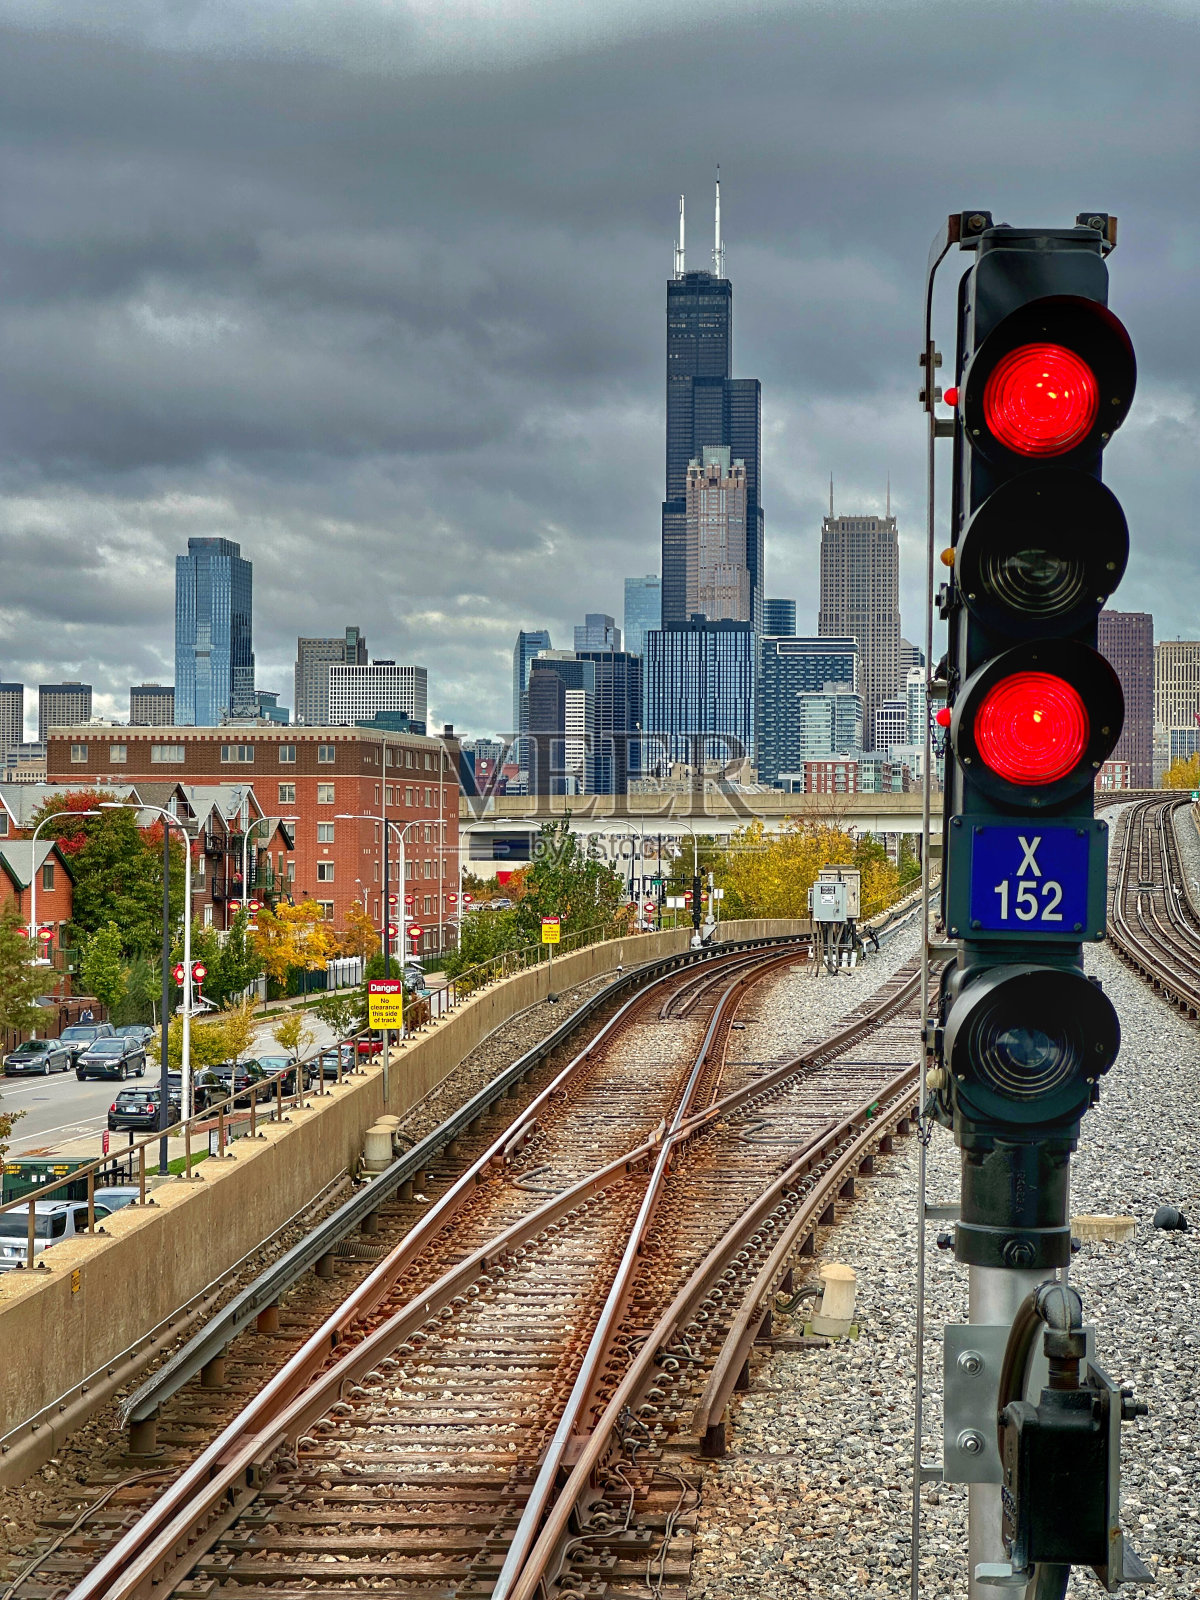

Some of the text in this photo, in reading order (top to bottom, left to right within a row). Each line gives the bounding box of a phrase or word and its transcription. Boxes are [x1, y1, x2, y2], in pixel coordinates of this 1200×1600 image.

[1016, 836, 1042, 877] X
[994, 880, 1063, 921] 152
[370, 984, 399, 993] Danger
